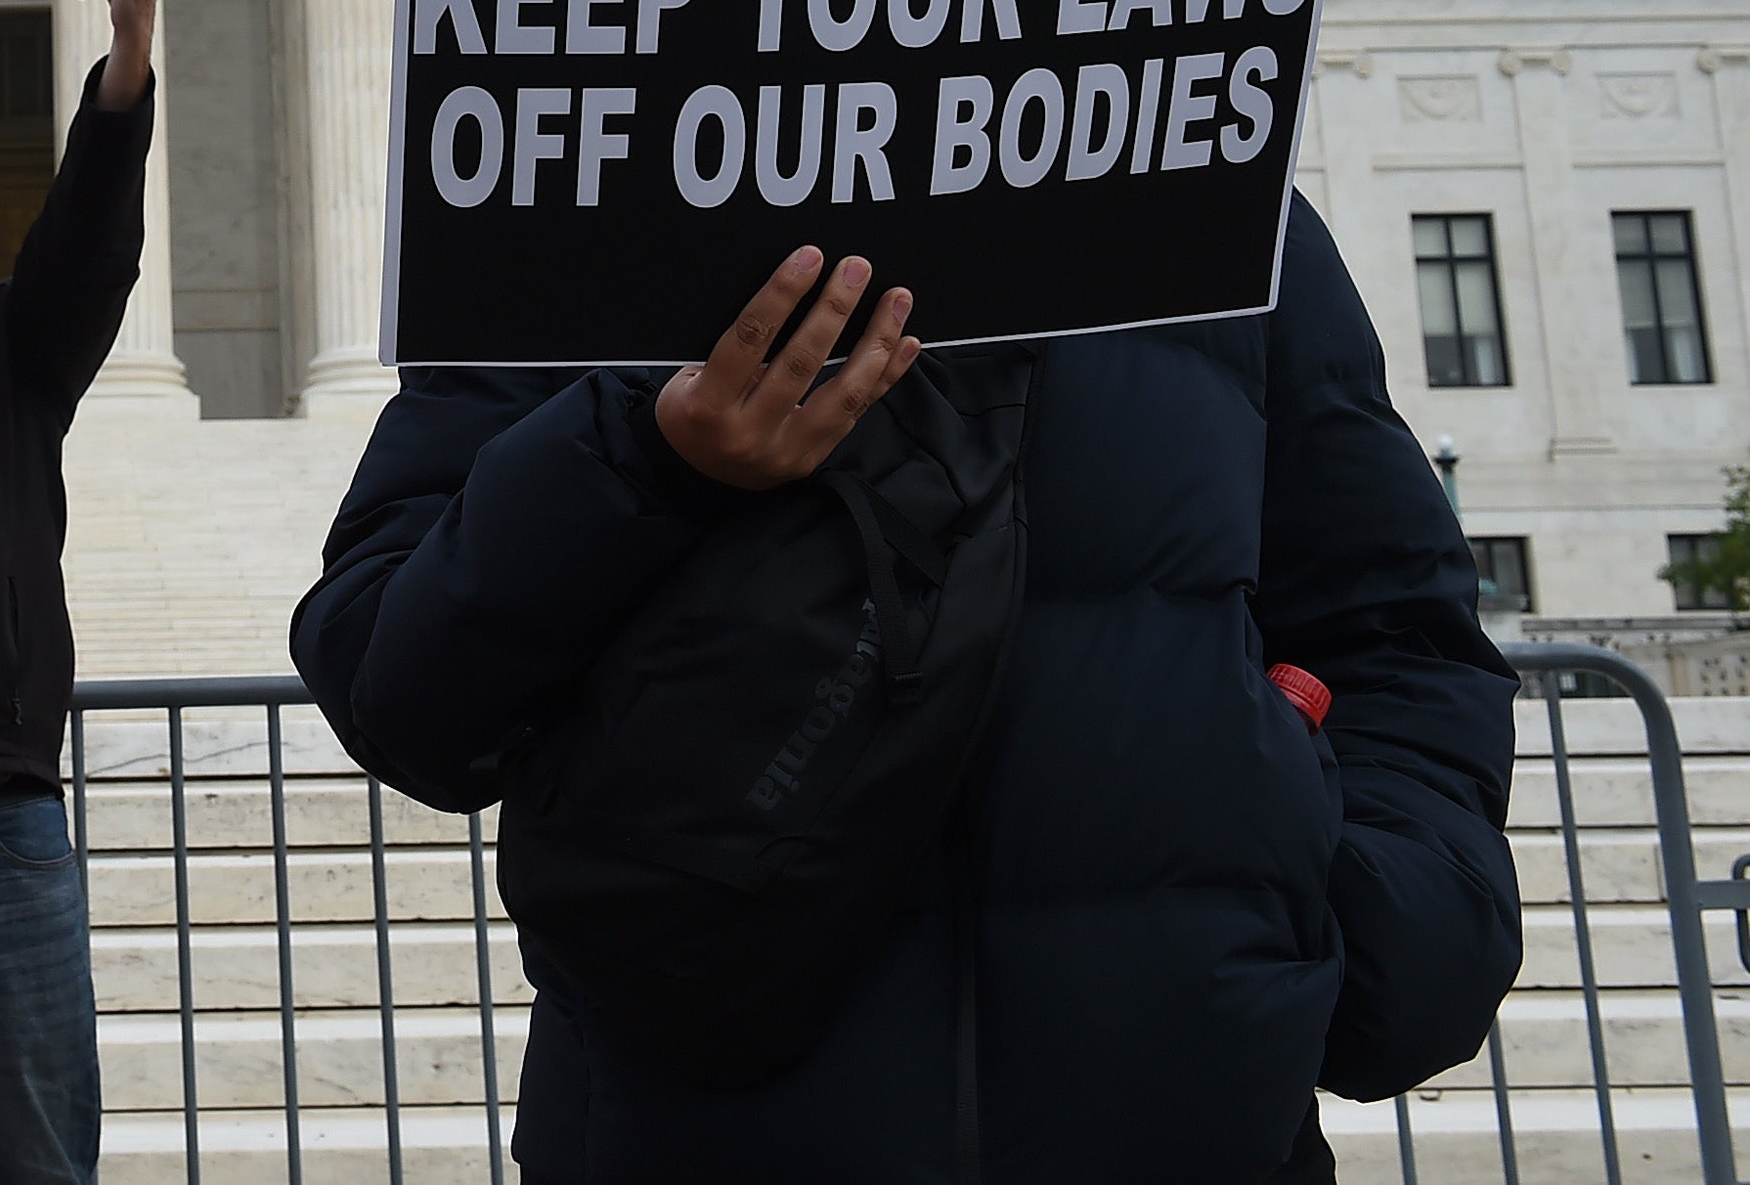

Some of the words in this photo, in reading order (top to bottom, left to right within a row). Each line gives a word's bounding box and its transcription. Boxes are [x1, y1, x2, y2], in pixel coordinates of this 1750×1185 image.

[430, 85, 637, 208] OFF
[672, 81, 898, 209] OUR
[929, 45, 1279, 196] BODIES
